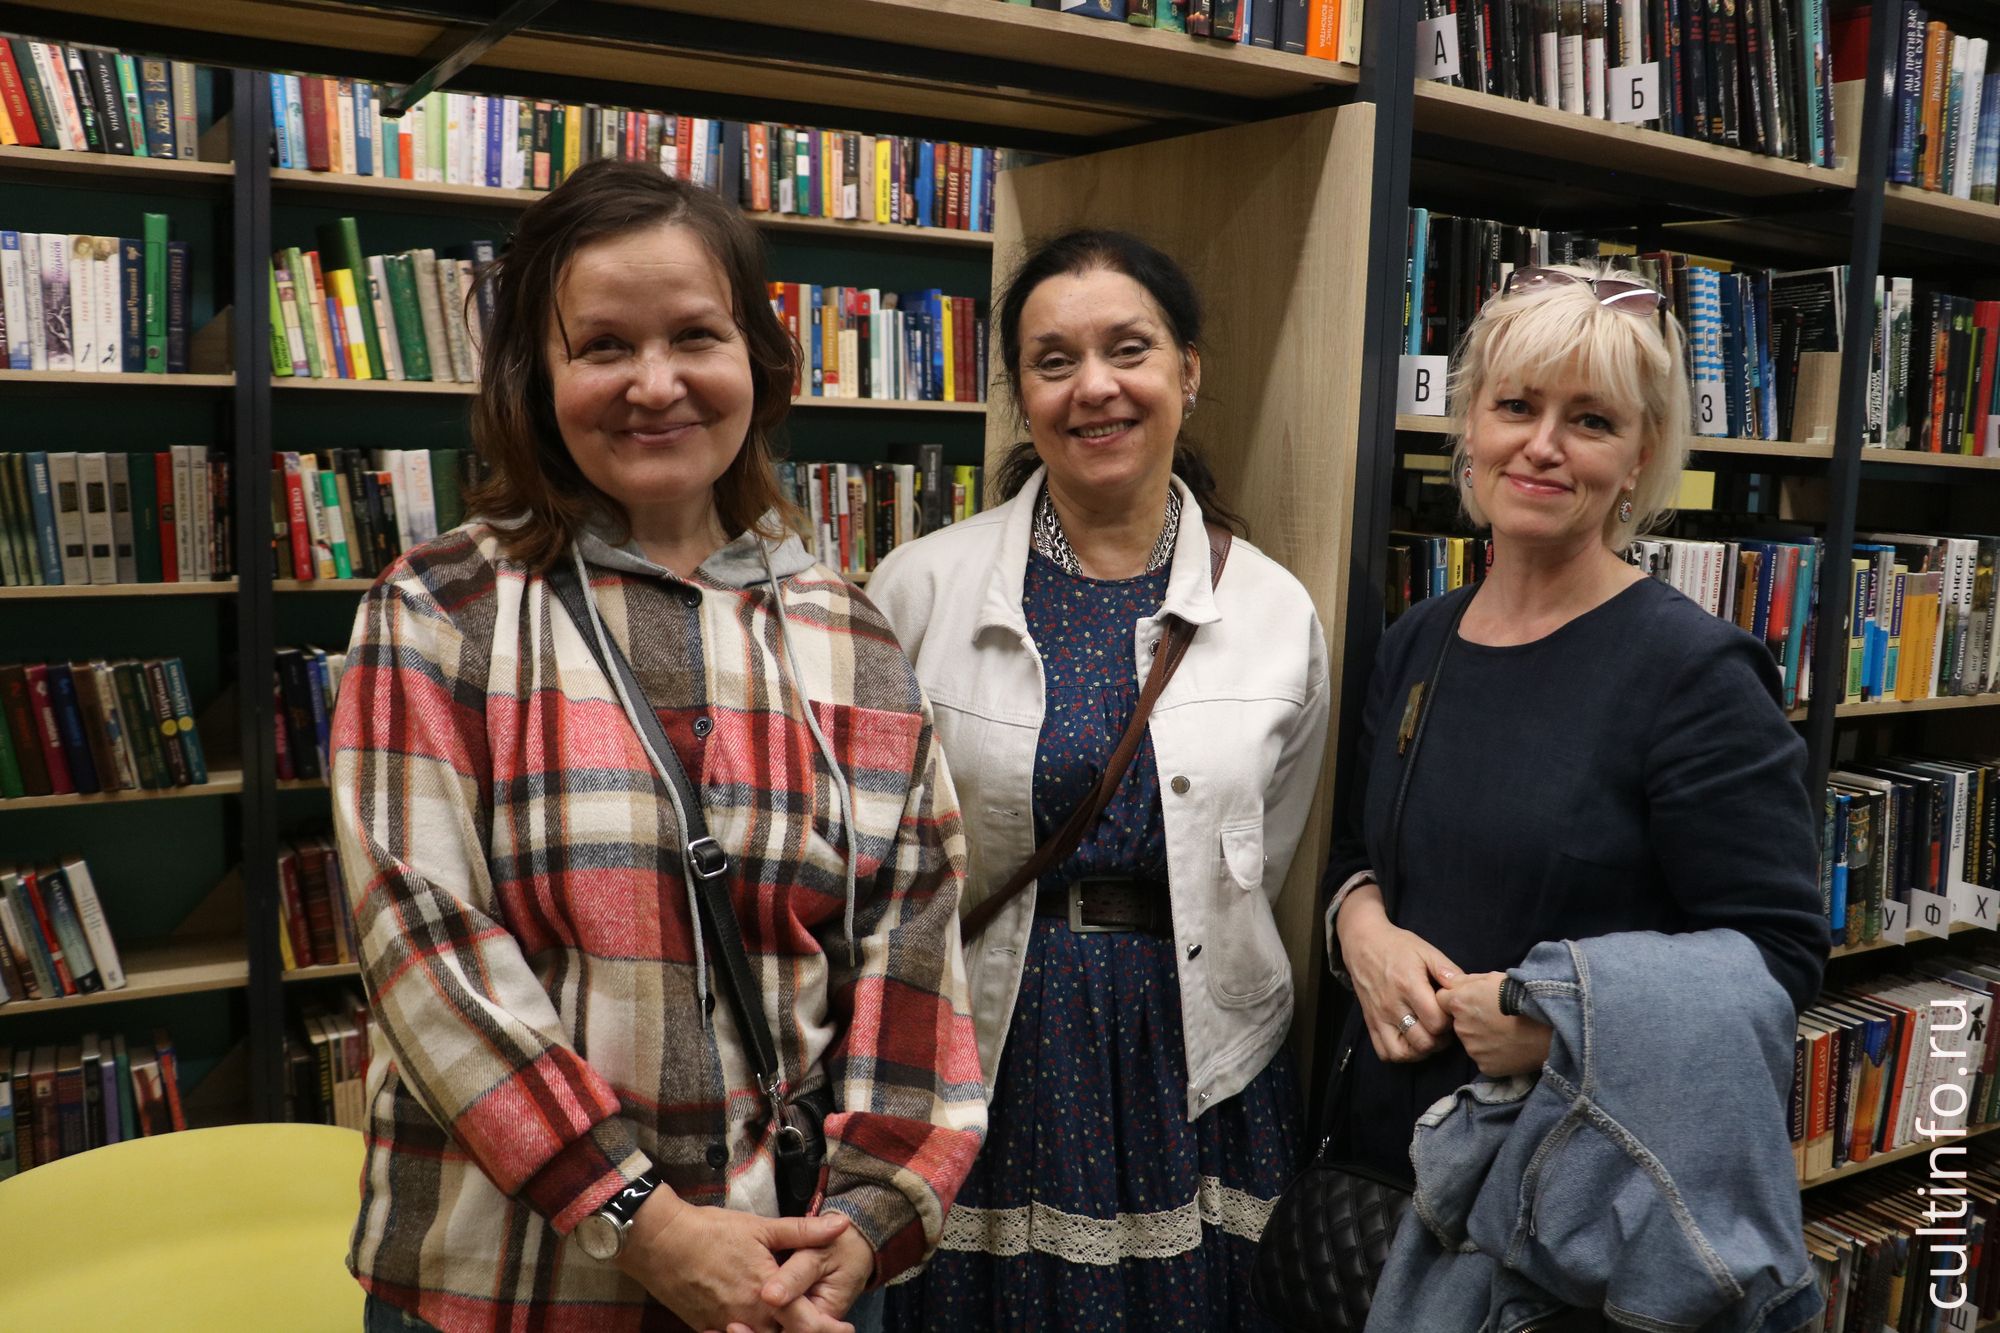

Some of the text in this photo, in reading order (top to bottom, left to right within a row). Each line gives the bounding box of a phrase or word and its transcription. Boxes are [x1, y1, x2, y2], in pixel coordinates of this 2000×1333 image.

[1319, 4, 1328, 48] ВОЛОНТЕРА
[1433, 31, 1447, 66] А
[1631, 77, 1645, 110] Б
[947, 172, 959, 216] ГЕНИЙ
[1415, 368, 1430, 402] В
[1711, 551, 1723, 599] ВОЗЖЕЛАЙ
[1857, 573, 1867, 619] МАККАЛОУ
[1925, 904, 1941, 926] Ф
